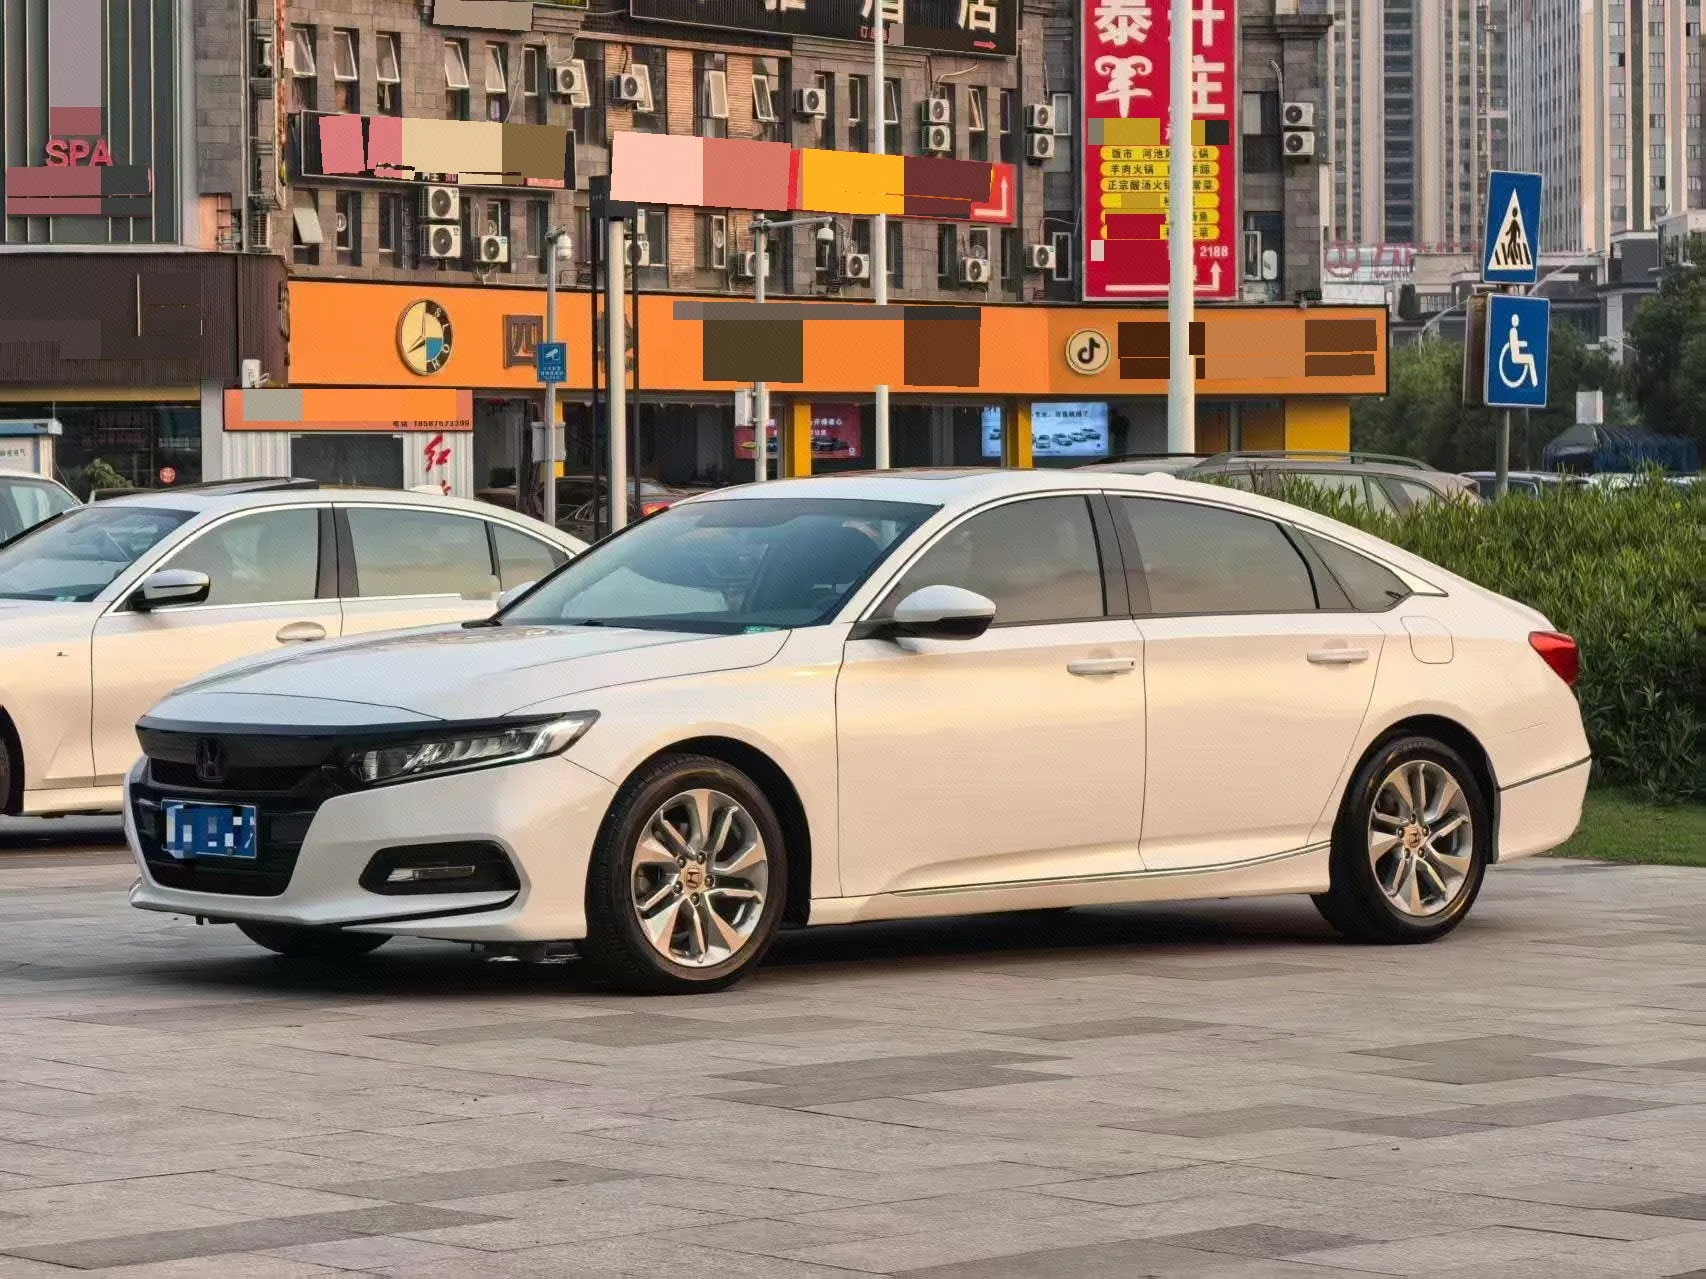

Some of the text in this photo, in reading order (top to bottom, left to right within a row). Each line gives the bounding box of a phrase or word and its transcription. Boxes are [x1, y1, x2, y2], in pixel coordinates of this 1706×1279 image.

[45, 138, 114, 167] SPA
[1110, 164, 1154, 175] 羊肉火锅
[1199, 245, 1229, 258] 2188
